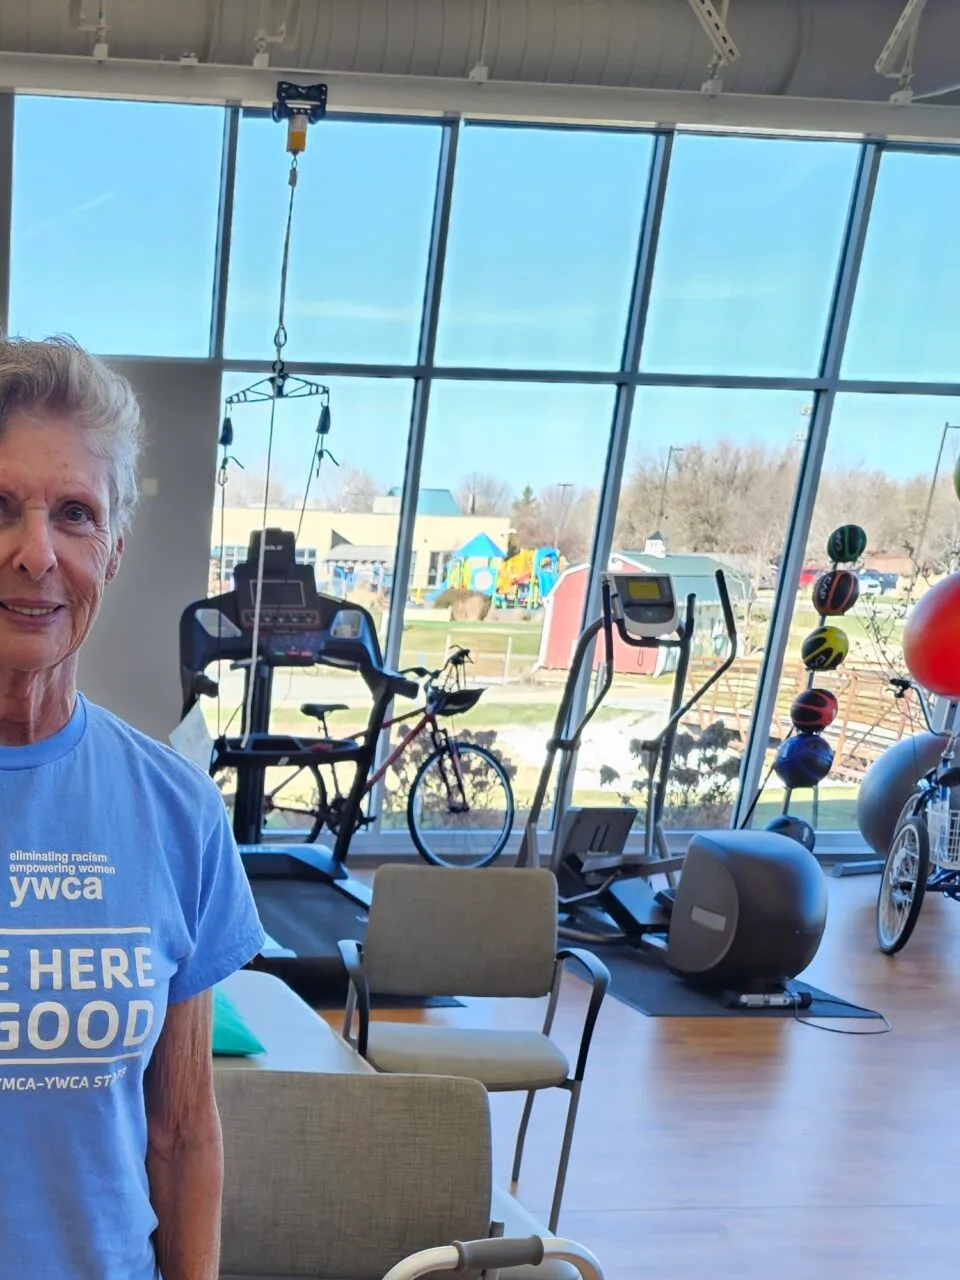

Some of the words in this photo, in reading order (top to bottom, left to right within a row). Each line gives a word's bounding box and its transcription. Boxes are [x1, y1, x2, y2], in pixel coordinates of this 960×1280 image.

[9, 850, 69, 864] eliminating
[71, 851, 108, 862] racism
[9, 862, 76, 875] empowering
[78, 863, 116, 875] women
[9, 876, 104, 908] ywca
[29, 946, 156, 991] HERE
